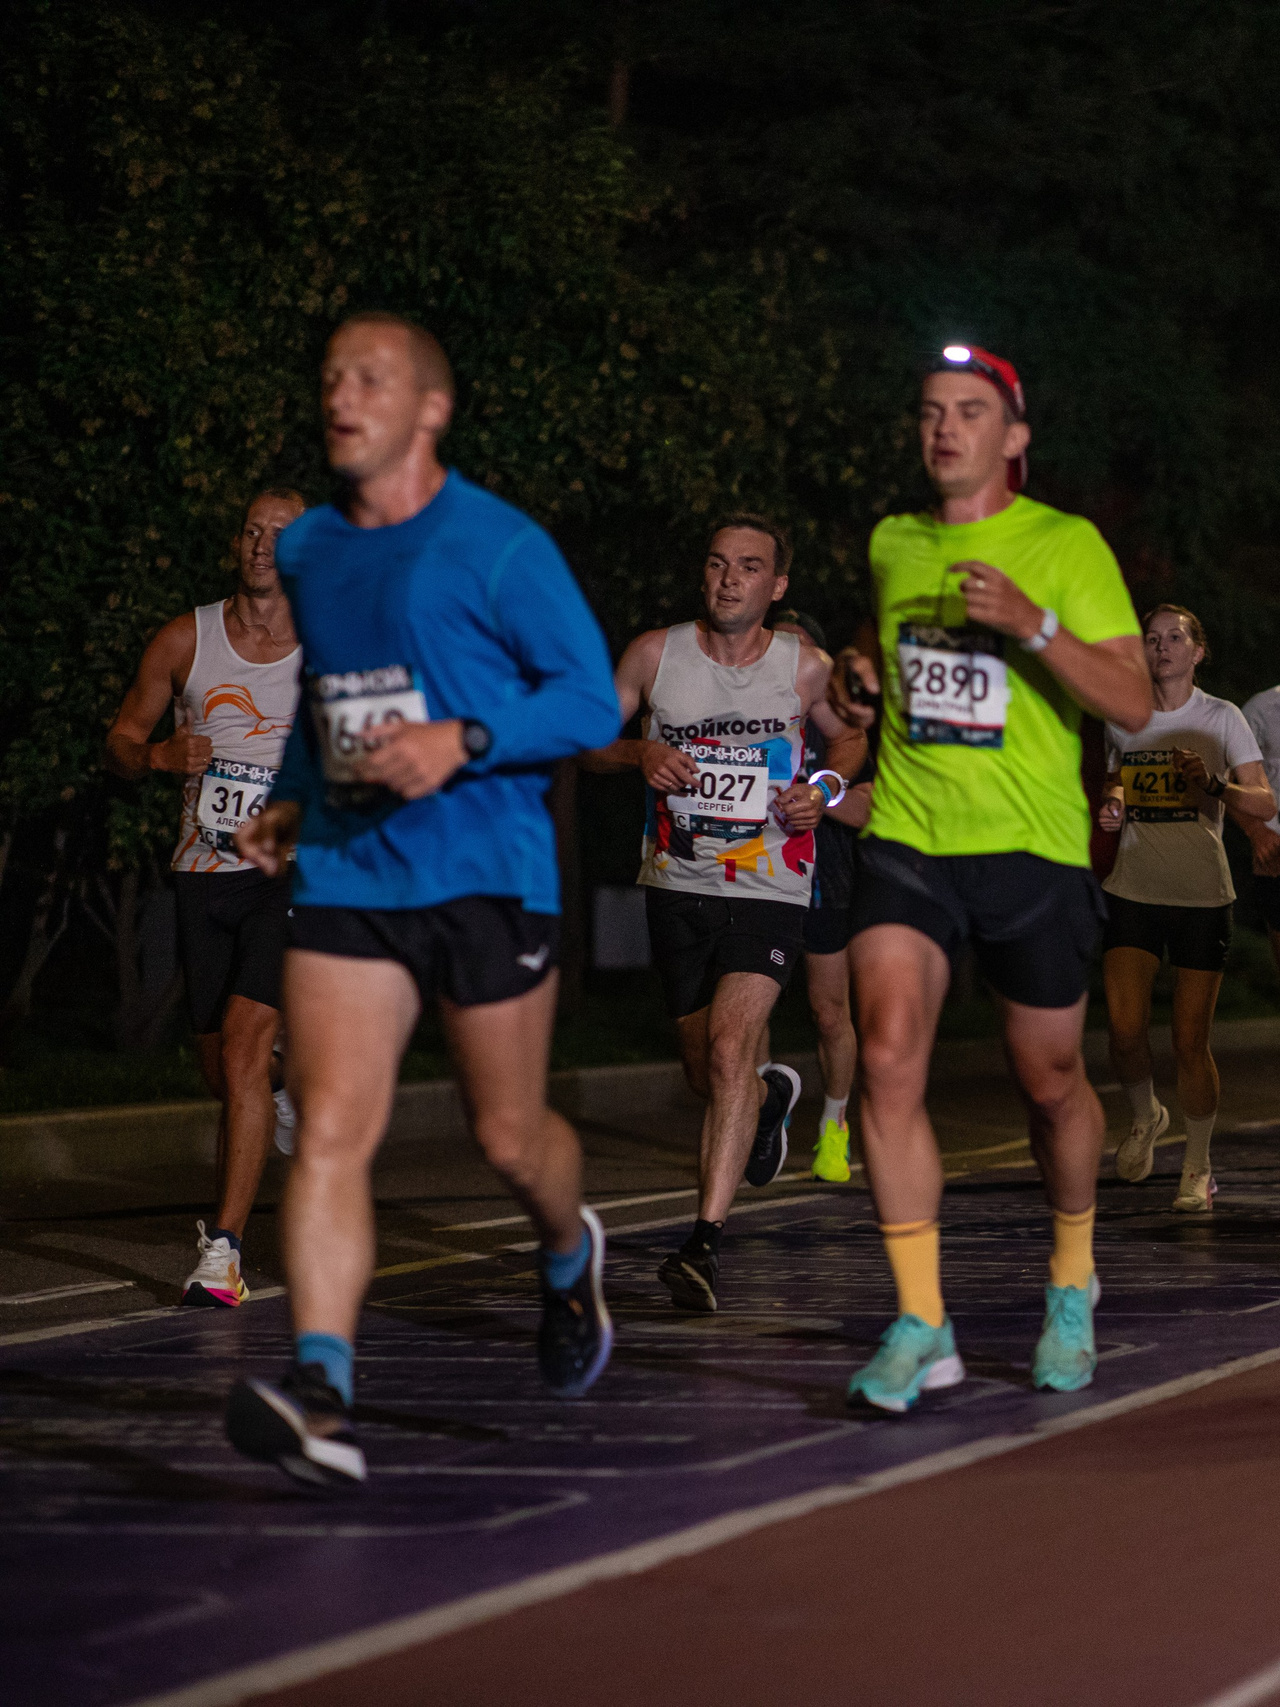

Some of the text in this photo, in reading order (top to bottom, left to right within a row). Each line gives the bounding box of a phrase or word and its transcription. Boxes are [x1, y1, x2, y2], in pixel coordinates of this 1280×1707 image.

[907, 658, 989, 702] 2890
[1132, 772, 1187, 793] 4216
[211, 786, 265, 819] 316
[697, 801, 734, 813] СЕРГЕЙ
[215, 816, 246, 829] АЛЕКС
